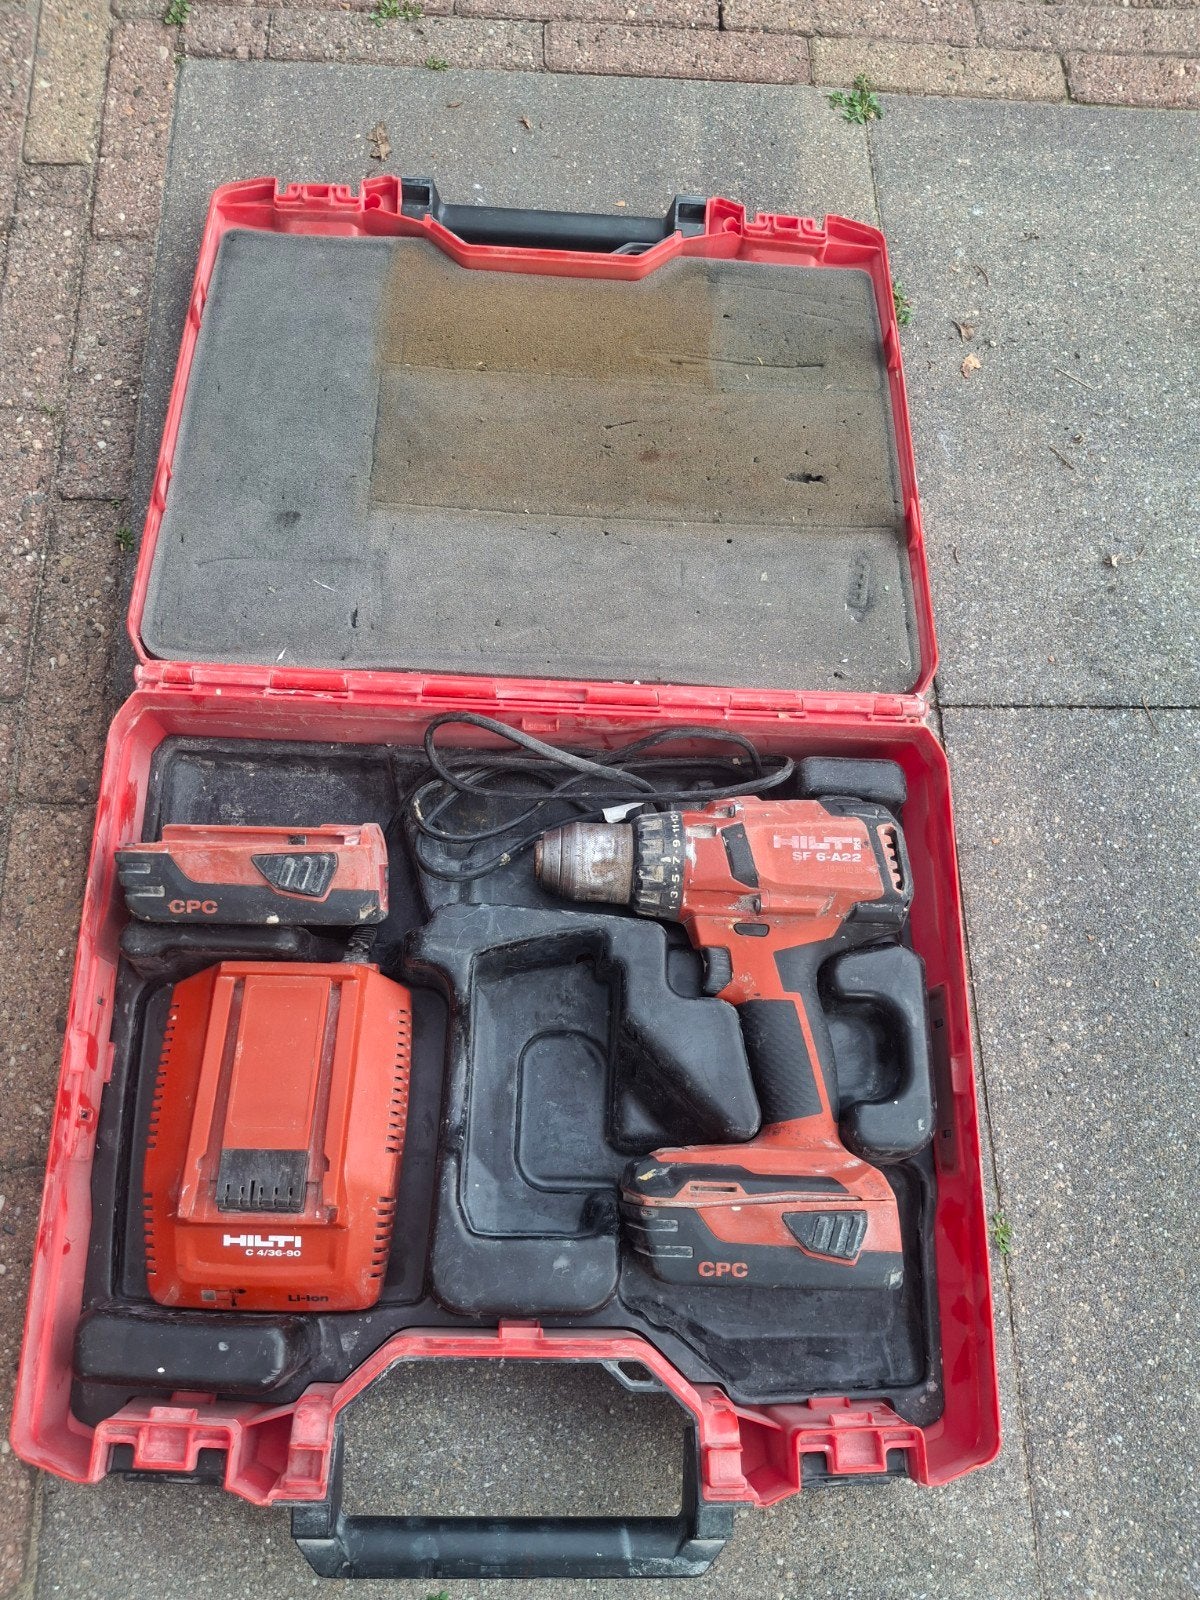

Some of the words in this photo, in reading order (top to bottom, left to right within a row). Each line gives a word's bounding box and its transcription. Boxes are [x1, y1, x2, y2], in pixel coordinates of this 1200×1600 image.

[773, 835, 862, 851] HILTI
[792, 851, 812, 861] SF
[815, 852, 862, 862] 6-A22
[168, 899, 218, 914] CPC
[222, 1234, 302, 1248] HILTI
[256, 1249, 301, 1257] 4/36-90
[698, 1261, 748, 1278] CPC
